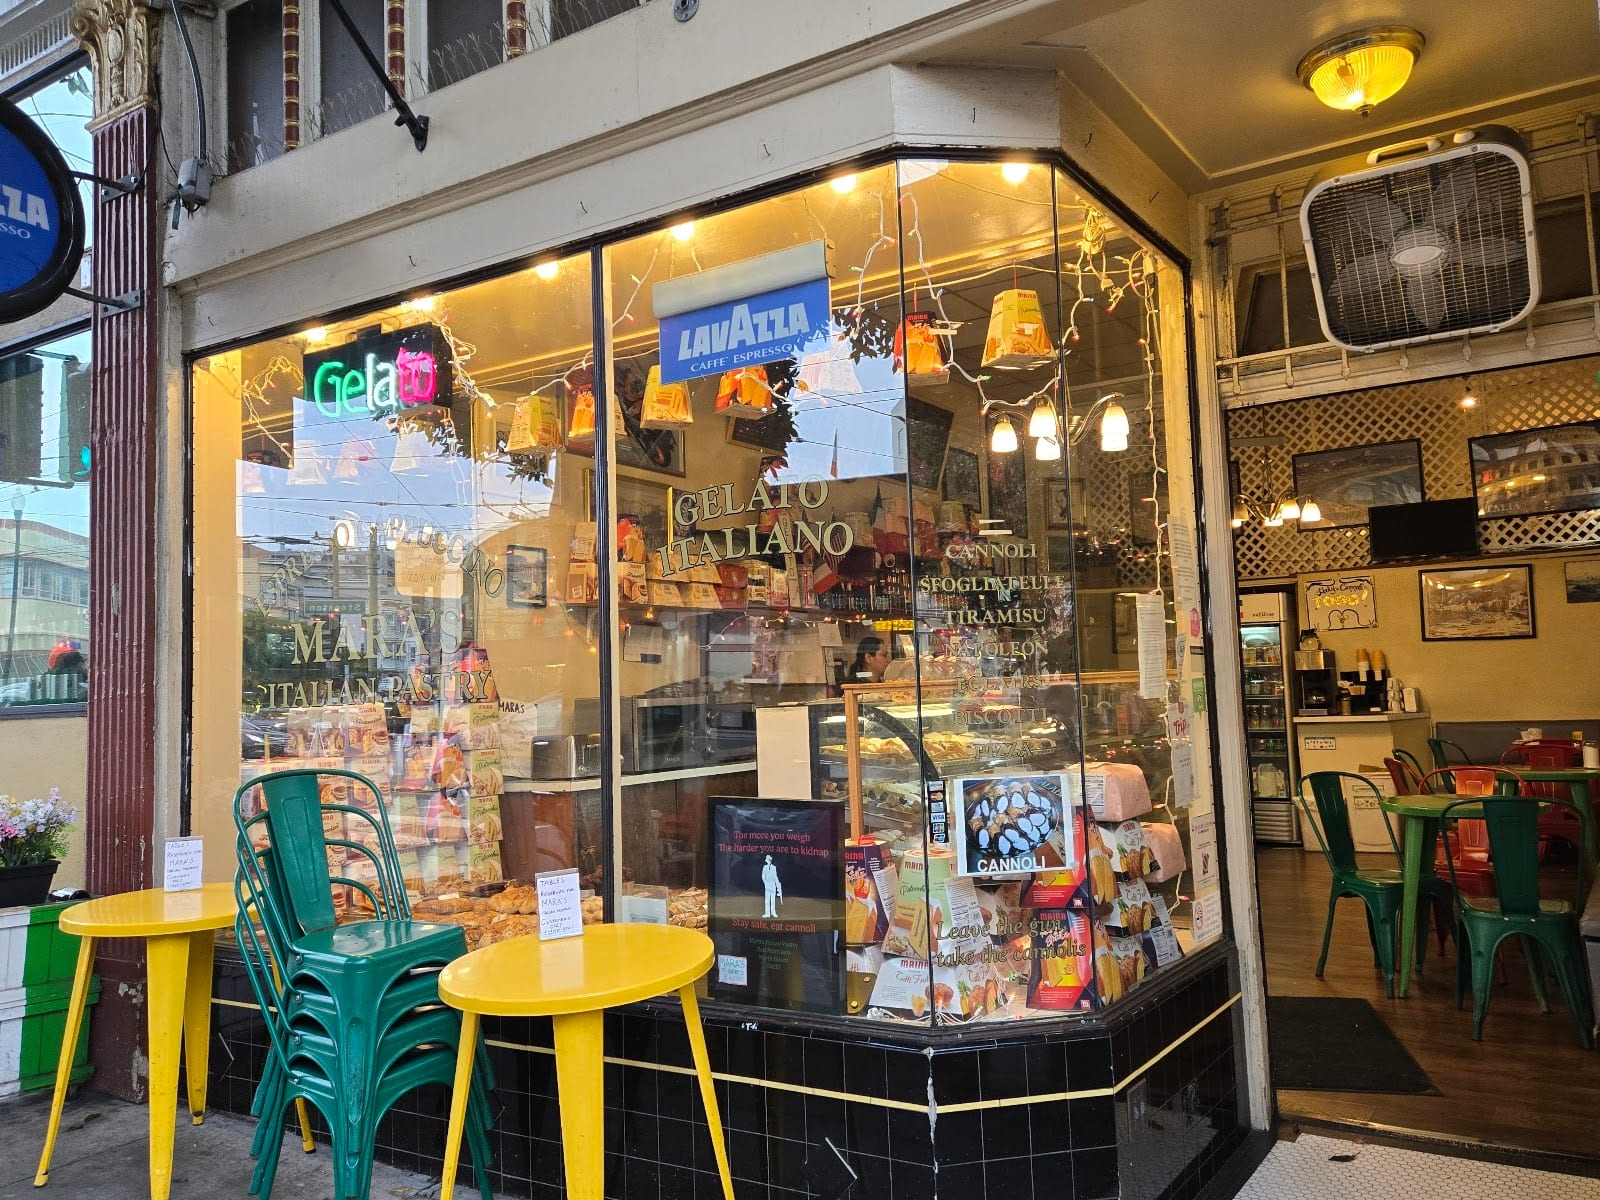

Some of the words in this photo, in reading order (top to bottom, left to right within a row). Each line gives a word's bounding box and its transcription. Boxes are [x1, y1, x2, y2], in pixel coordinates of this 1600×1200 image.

[0, 184, 49, 231] ZA
[678, 302, 810, 361] LAVAZZA
[733, 343, 793, 364] ESPRESSO
[313, 347, 437, 418] Gelato
[674, 473, 829, 526] GELATO
[656, 520, 854, 577] ITALIANO
[945, 543, 1038, 559] CANNOLI
[919, 575, 1066, 592] SFOGLIATELLE
[944, 607, 1047, 625] TIRAMISU
[291, 606, 464, 665] MARA'S
[944, 640, 1049, 657] NAPOLEON
[267, 677, 378, 709] ITALIAN
[388, 669, 492, 704] PASTRY
[955, 674, 1043, 691] ECLAIRS
[953, 707, 1049, 724] BISCOTTI
[974, 742, 1034, 759] PIZZA
[733, 830, 748, 840] The
[749, 831, 769, 840] more
[770, 833, 785, 842] you
[786, 831, 811, 844] weigh
[718, 843, 733, 852] The
[733, 843, 759, 853] harder
[760, 844, 774, 854] you
[790, 846, 799, 855] to
[800, 846, 829, 858] kidnap
[844, 852, 864, 860] AINA
[904, 861, 924, 870] MAIN
[977, 856, 1046, 872] CANNOLI
[731, 917, 750, 931] Stay
[770, 921, 784, 932] eat
[785, 921, 817, 933] cannoli
[935, 920, 991, 940] Leave
[996, 917, 1023, 936] the
[1029, 918, 1068, 938] gun,
[936, 946, 977, 967] take
[980, 943, 1009, 962] the
[1013, 939, 1087, 962] cannolis
